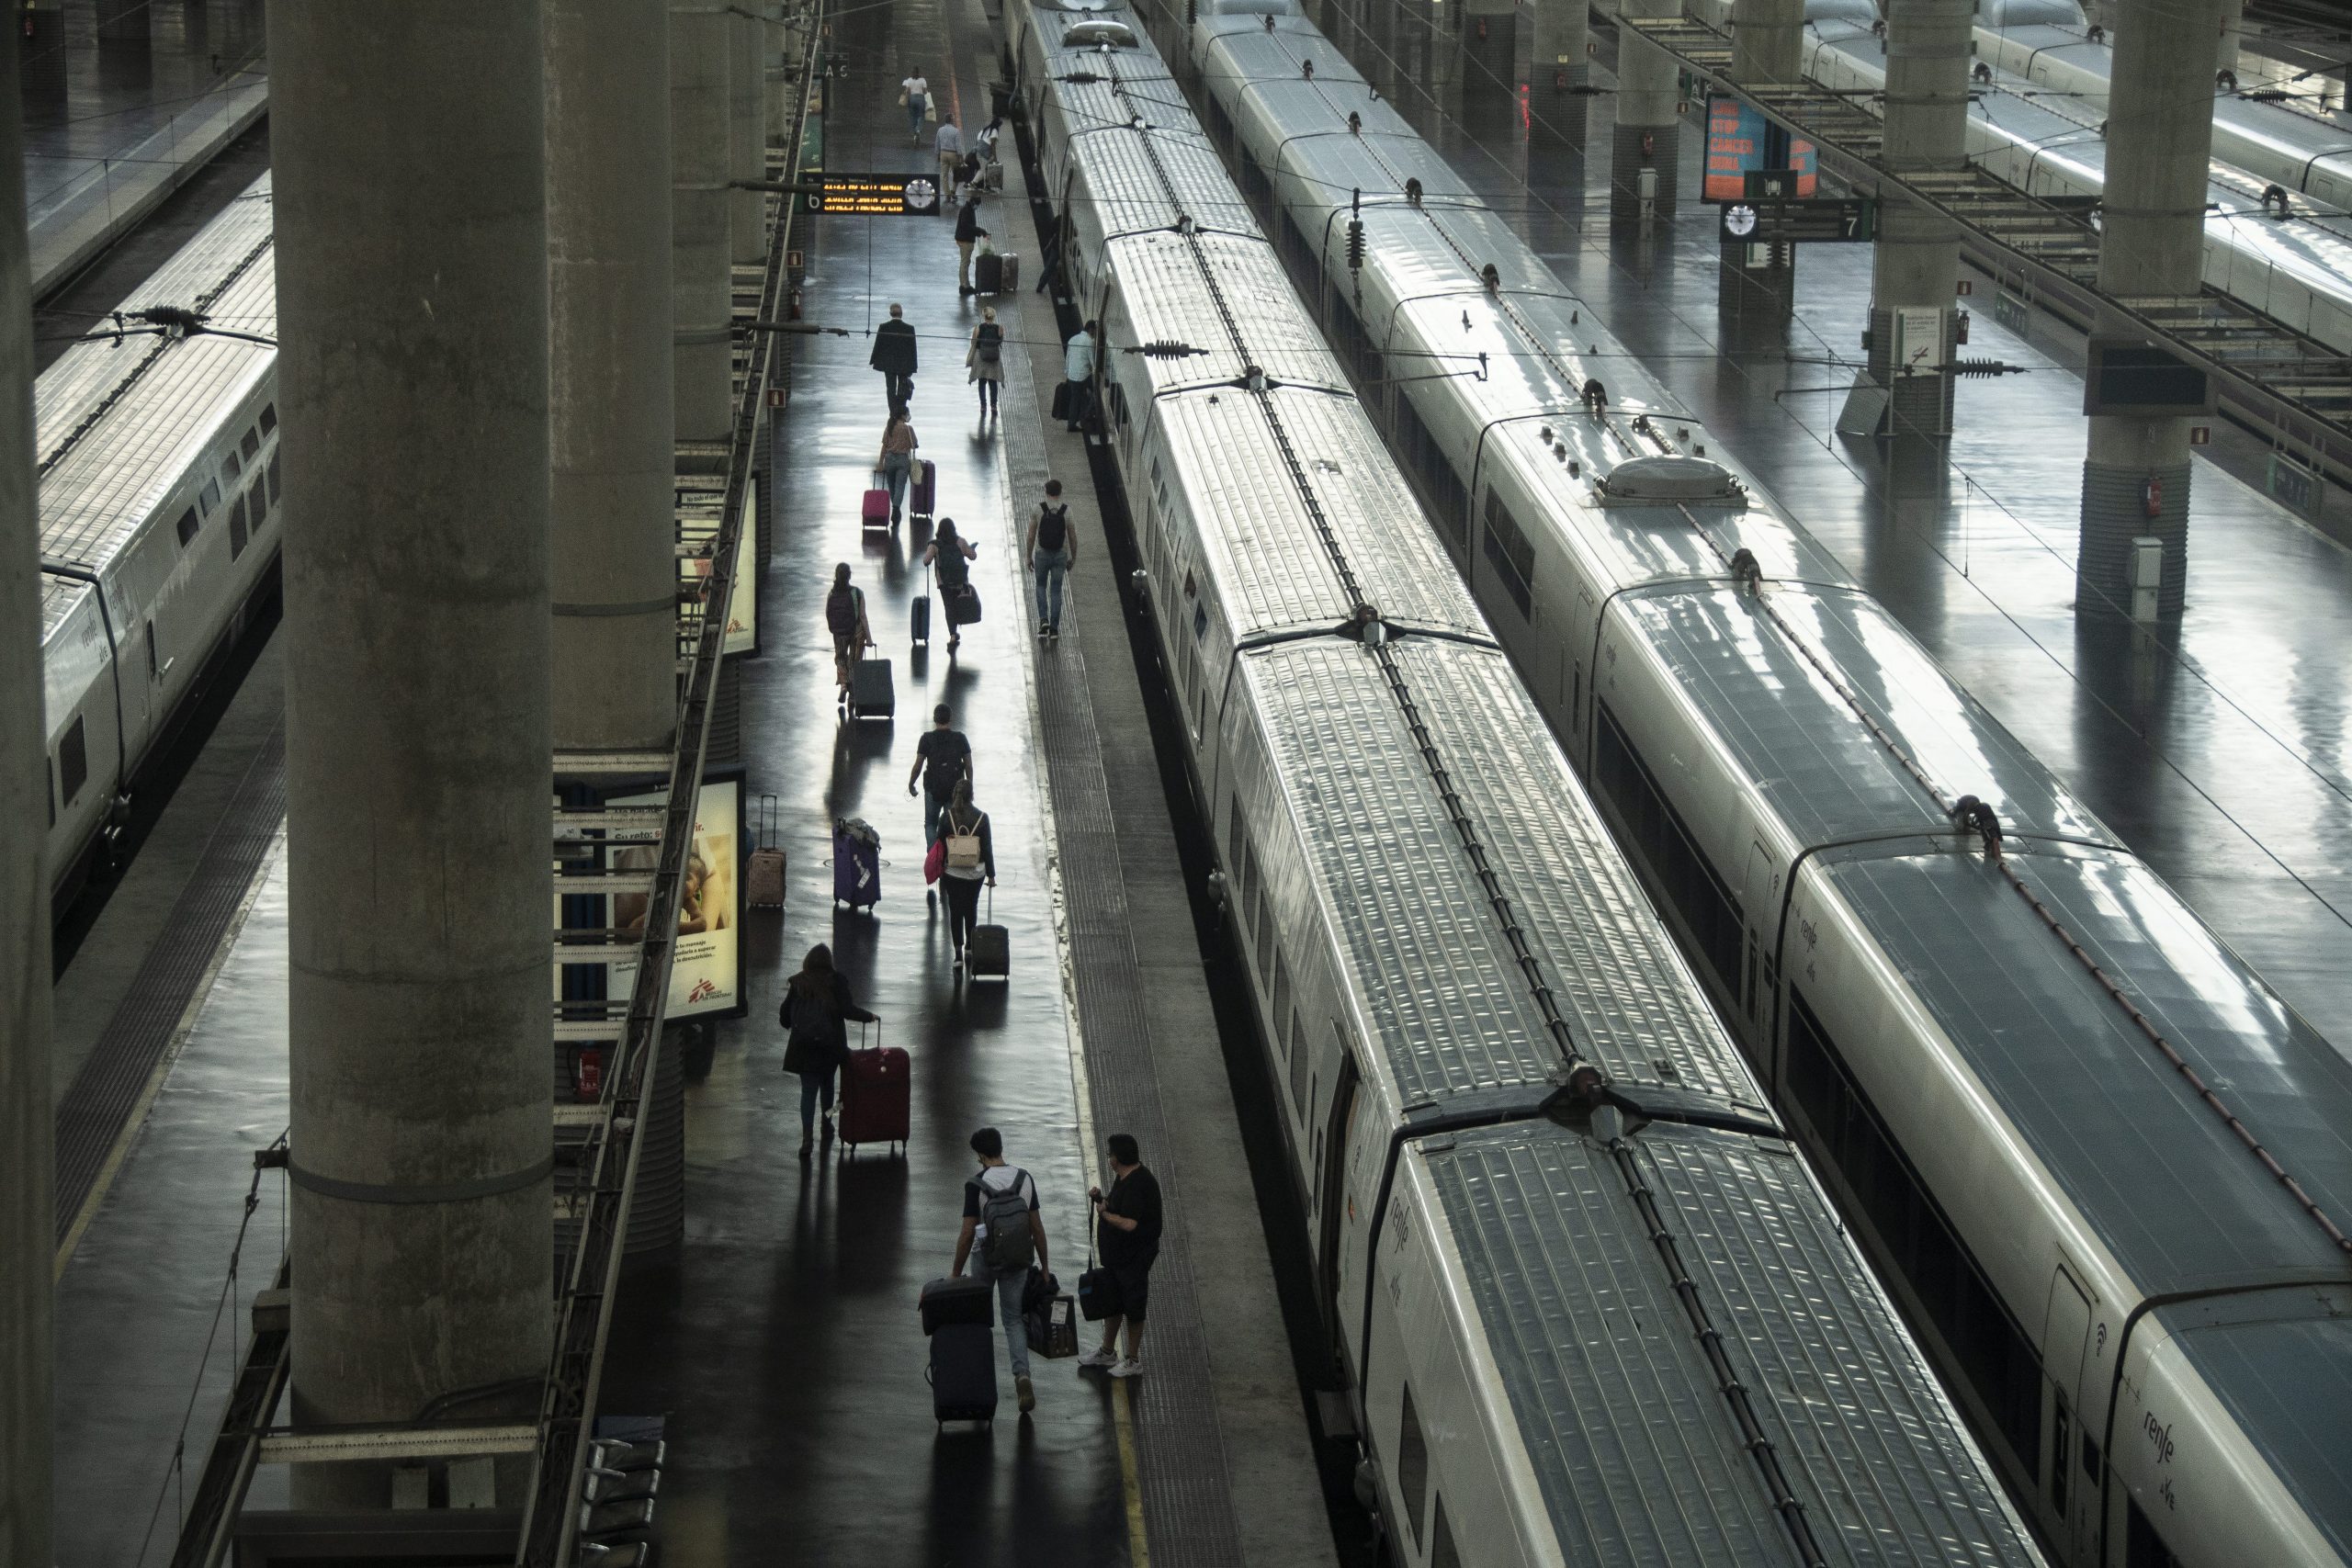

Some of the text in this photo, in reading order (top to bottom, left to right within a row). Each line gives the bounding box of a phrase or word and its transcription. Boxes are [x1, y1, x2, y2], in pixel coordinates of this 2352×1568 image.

[1845, 217, 1858, 237] 7
[1389, 1194, 1410, 1255] renfe
[2143, 1410, 2175, 1464] renfe
